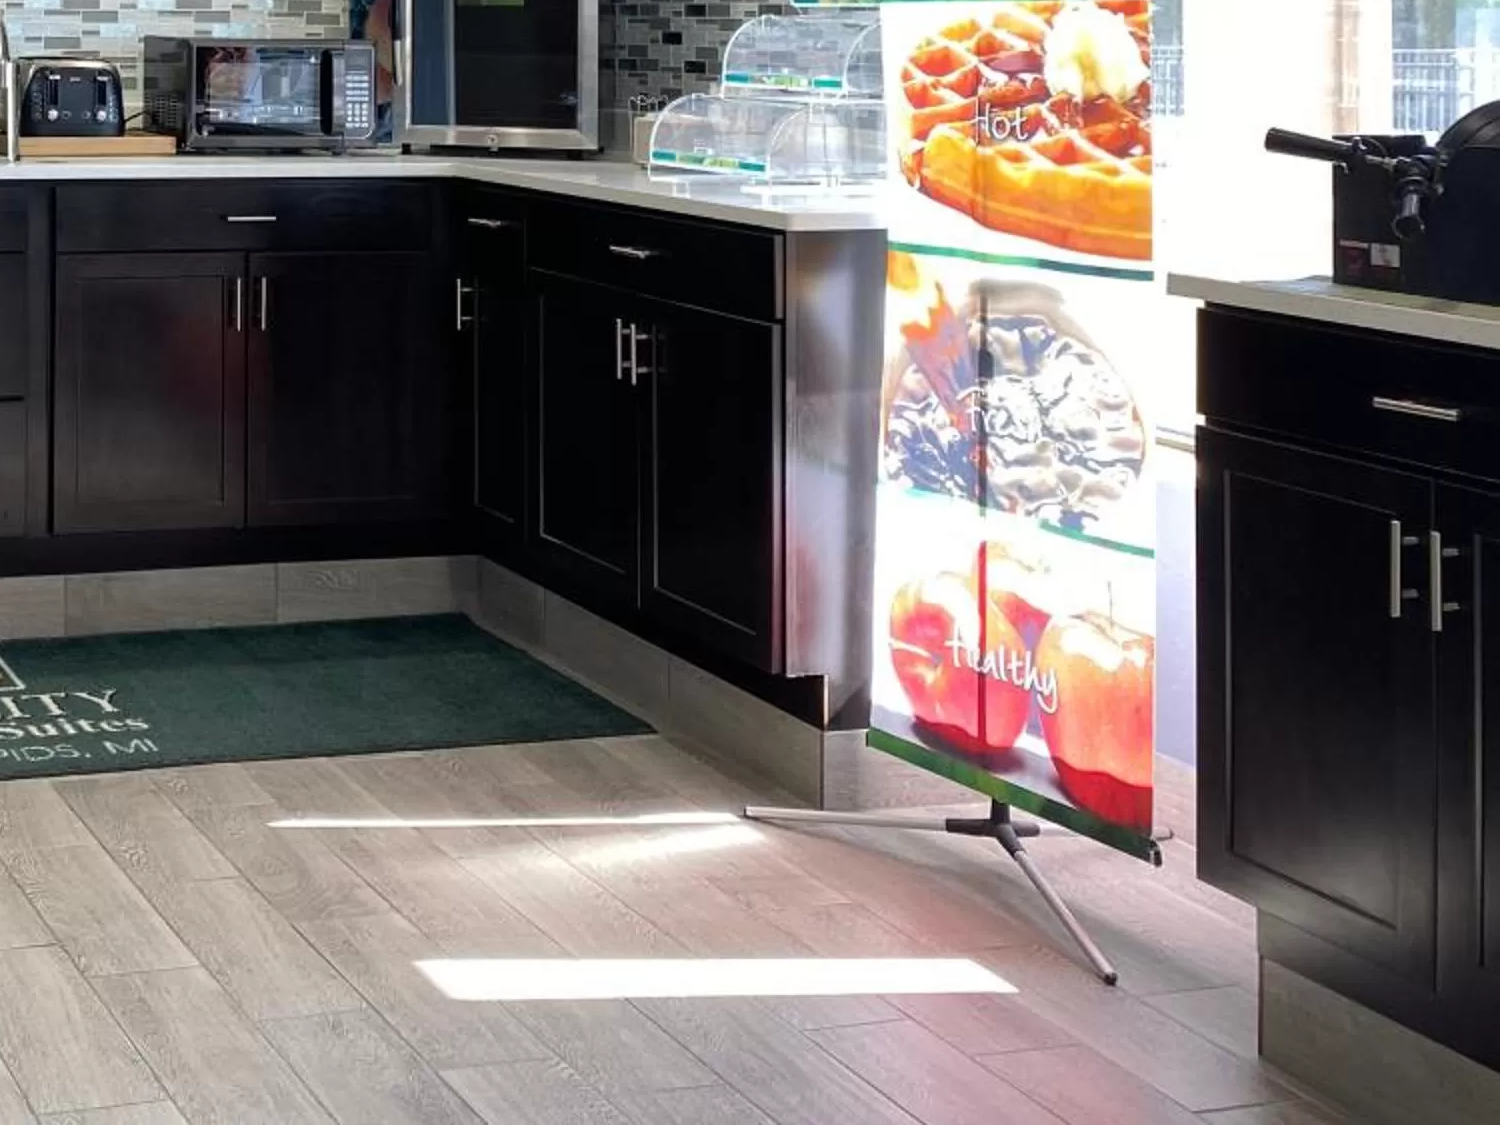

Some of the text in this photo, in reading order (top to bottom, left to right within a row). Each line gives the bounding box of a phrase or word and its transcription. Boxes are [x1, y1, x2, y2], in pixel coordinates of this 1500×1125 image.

[972, 98, 1028, 143] Hot
[944, 626, 1059, 714] Healthy
[102, 738, 159, 755] MI
